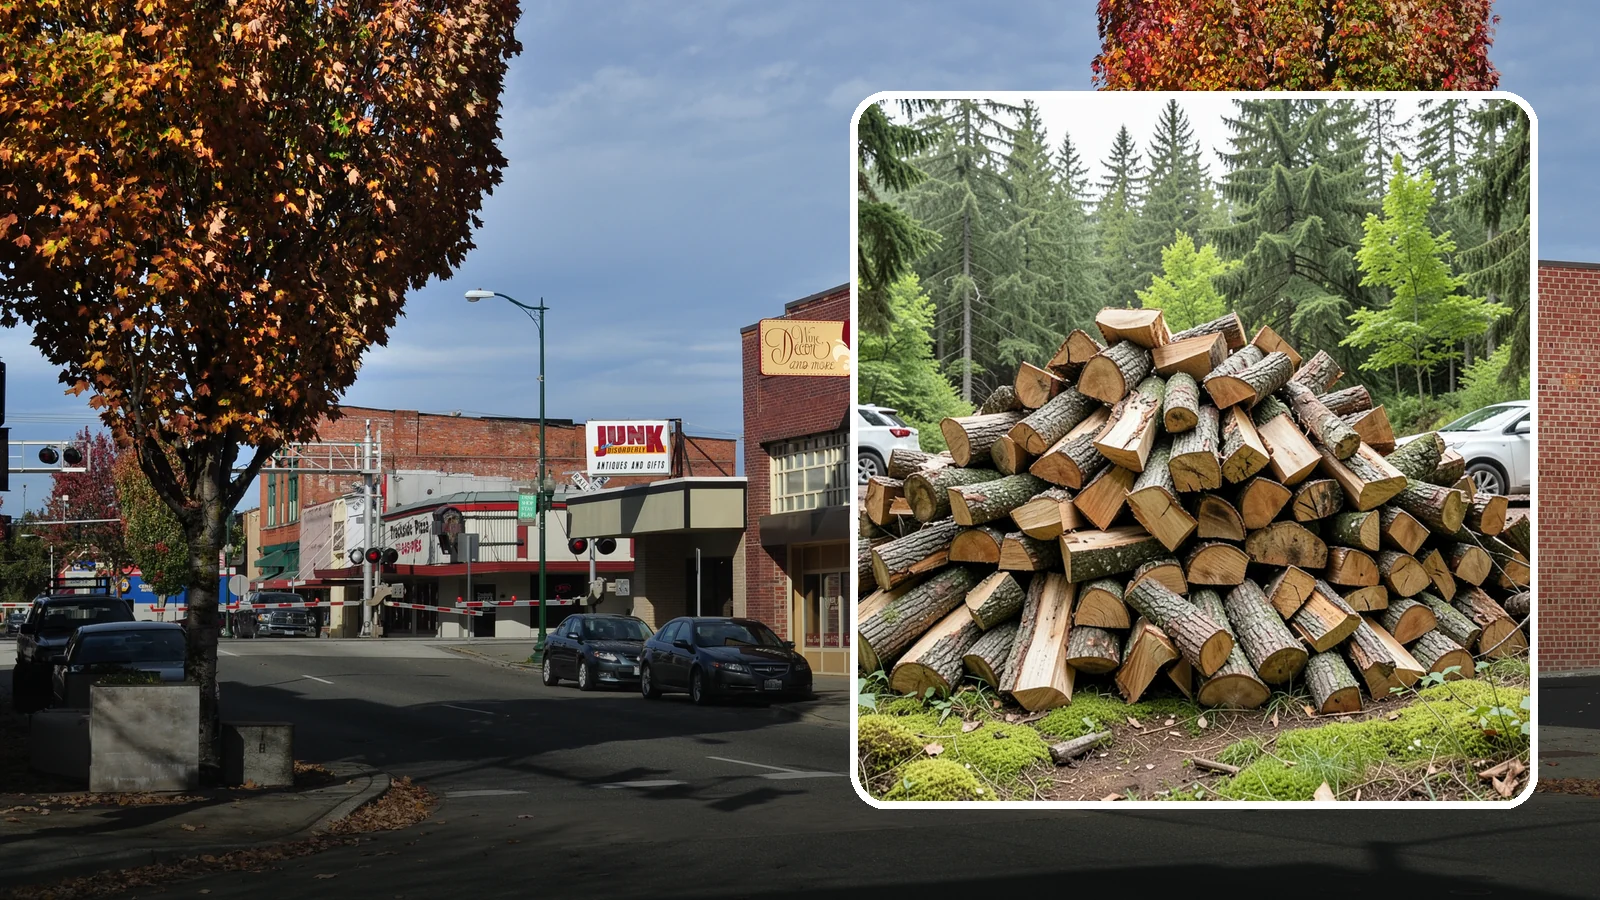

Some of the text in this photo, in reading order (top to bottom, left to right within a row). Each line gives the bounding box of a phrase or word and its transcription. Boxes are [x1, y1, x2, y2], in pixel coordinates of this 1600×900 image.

[595, 425, 665, 457] JUNK
[607, 446, 646, 454] DISORDERLY
[597, 460, 665, 470] ANTIQUES AND GIFTS
[390, 520, 429, 539] Trackside Pizza
